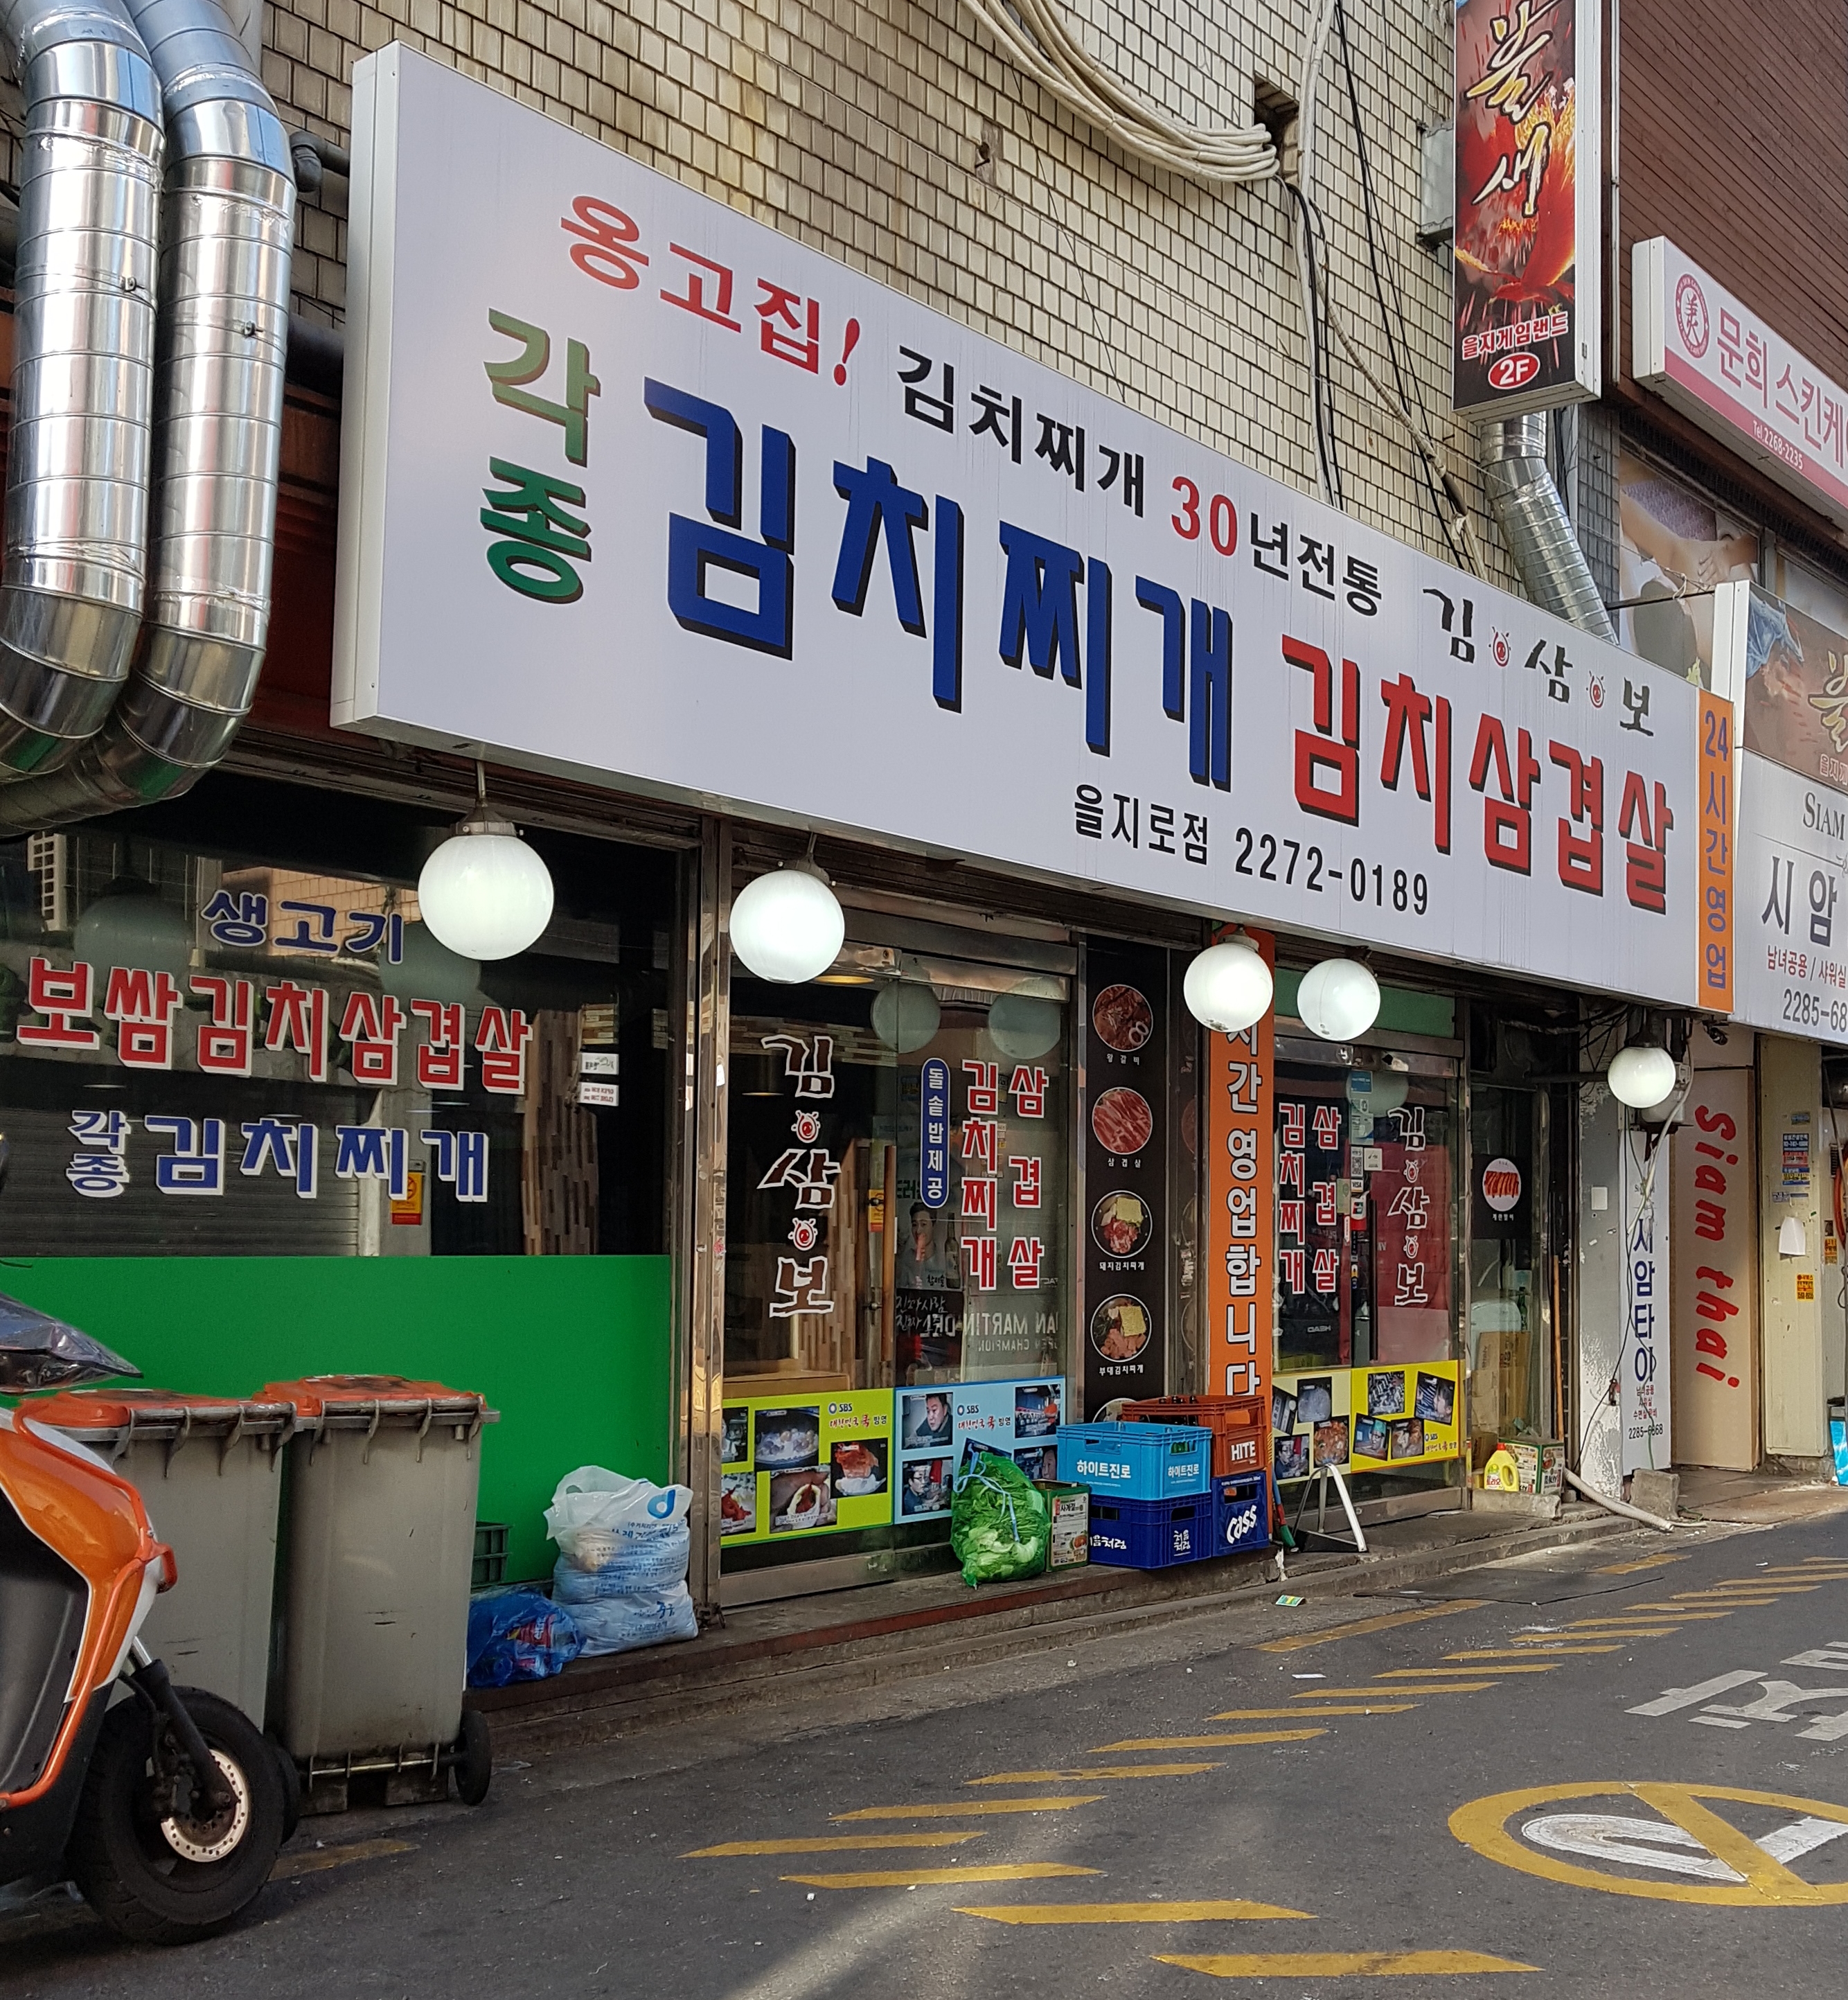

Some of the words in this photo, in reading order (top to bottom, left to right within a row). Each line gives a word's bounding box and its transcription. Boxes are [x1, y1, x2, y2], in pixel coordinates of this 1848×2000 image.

[561, 195, 860, 386] 옹고집!
[1462, 312, 1568, 360] 을지게임랜드
[1499, 358, 1530, 385] 2F
[896, 344, 1144, 518] 김치찌개
[1717, 306, 1768, 409] 문희
[1775, 363, 1848, 469] 스킨케
[480, 308, 601, 604] 각종
[643, 376, 1233, 793] 김치찌개
[1281, 634, 1675, 916] 김치삼겹살
[1073, 784, 1209, 866] 을지로점
[1235, 827, 1429, 916] 2272-0189
[202, 889, 403, 965] 생고기
[1768, 944, 1807, 979] 남녀공용
[66, 1109, 133, 1198] 각종
[143, 1115, 489, 1203] 김치찌개
[927, 1067, 944, 1201] 돌솥밥제공
[961, 1059, 998, 1291] 김치찌개
[1007, 1065, 1049, 1291] 삼겹살
[1107, 1158, 1141, 1169] 삼겹살
[1694, 1104, 1739, 1241] Siam
[1279, 1103, 1306, 1294] 김치찌개
[1313, 1106, 1342, 1293] 삼겹살
[1696, 1266, 1740, 1389] thai
[839, 1403, 853, 1413] SBS
[873, 1415, 887, 1425] 방영
[966, 1404, 979, 1414] SBS
[998, 1417, 1011, 1427] 방영
[1230, 1440, 1256, 1462] HITE
[1076, 1459, 1131, 1479] 하이트진로
[1167, 1464, 1200, 1478] 하이트진로
